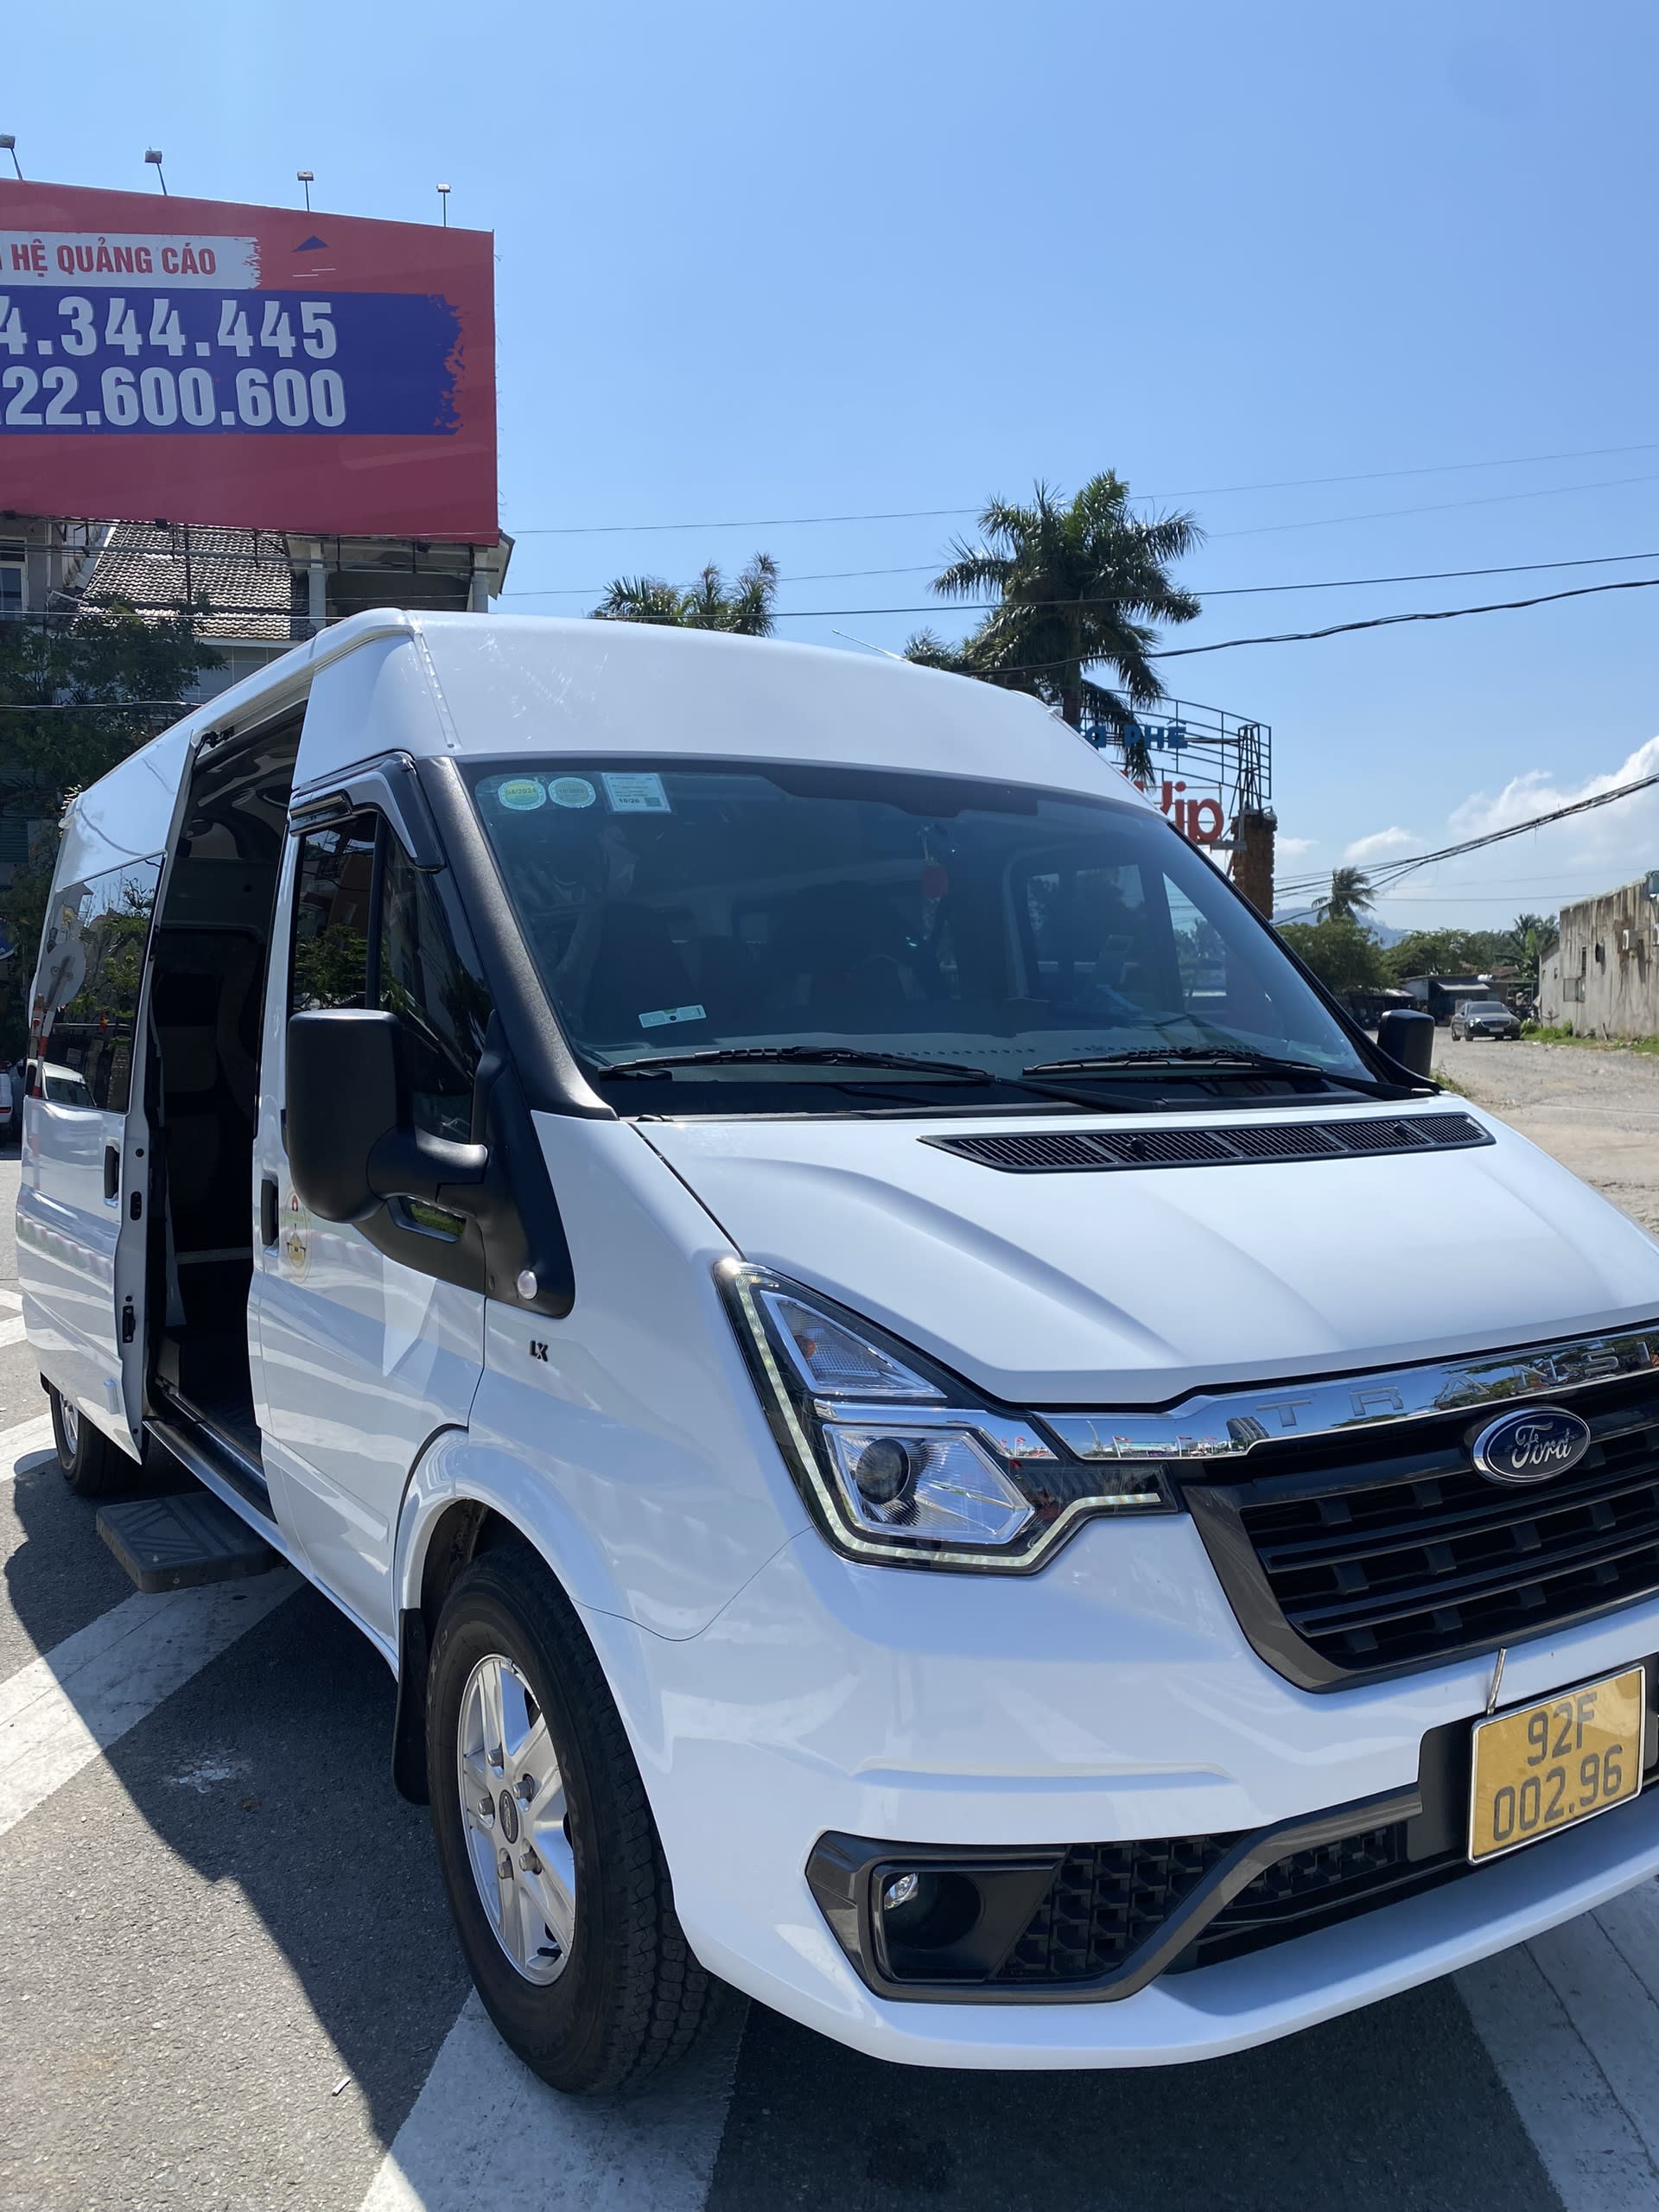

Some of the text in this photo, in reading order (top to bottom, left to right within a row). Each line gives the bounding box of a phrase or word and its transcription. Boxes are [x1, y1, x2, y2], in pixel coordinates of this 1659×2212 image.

[10, 238, 48, 276] HỆ
[56, 237, 153, 275] QUẢNG
[162, 242, 216, 275] CÁO
[0, 295, 337, 359] 4.344.445
[0, 365, 346, 427] 22.600.600
[530, 1340, 548, 1362] LX
[1510, 1422, 1573, 1469] Ford
[1527, 1693, 1598, 1766] 92F
[1493, 1744, 1623, 1841] 002.96
